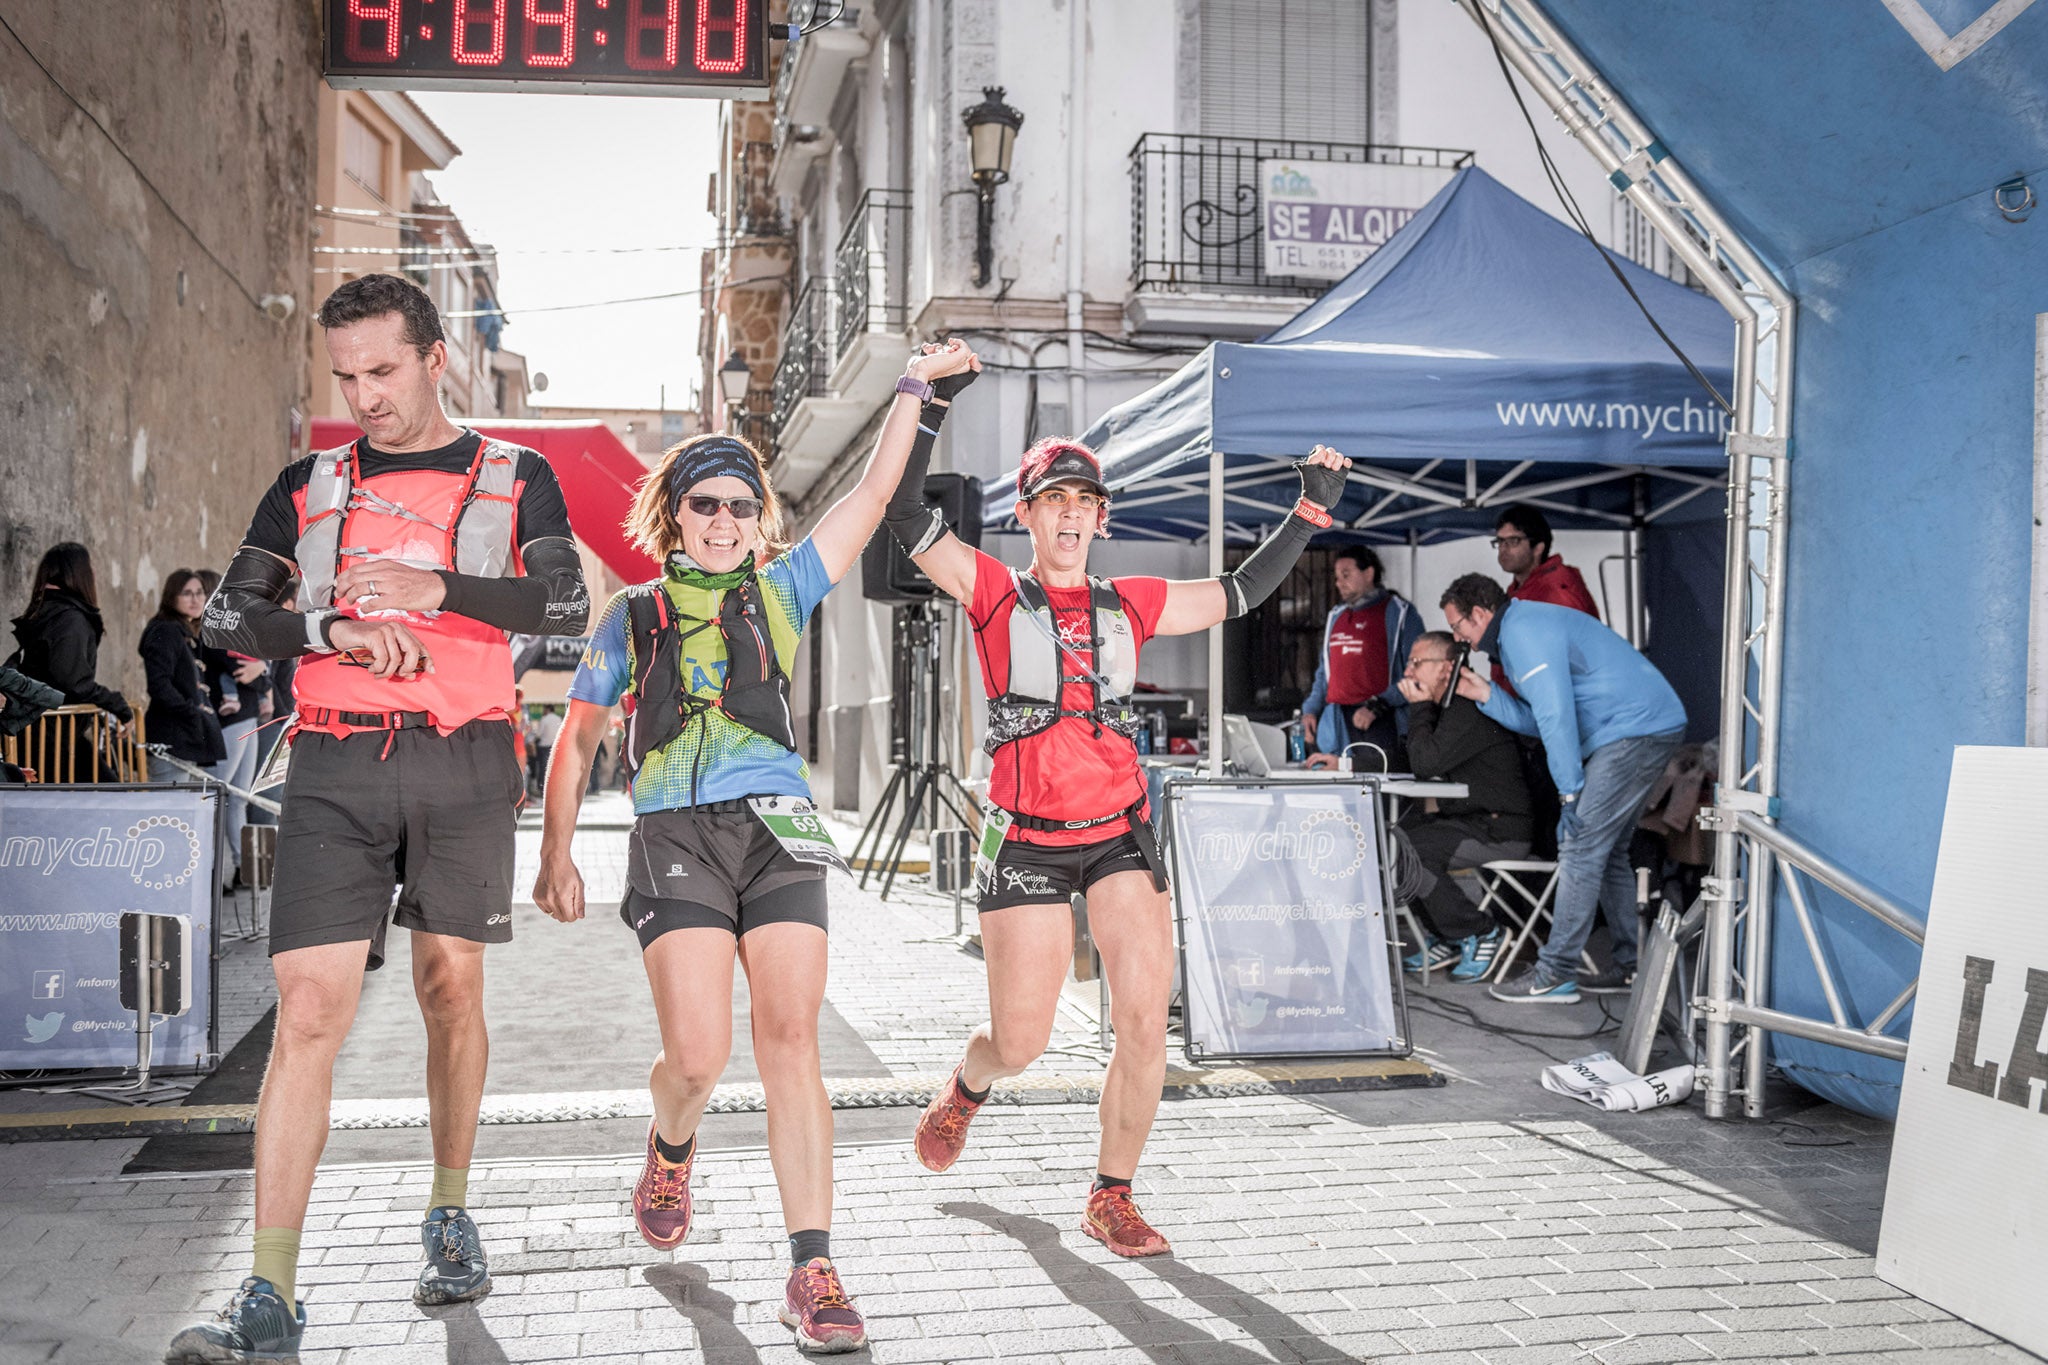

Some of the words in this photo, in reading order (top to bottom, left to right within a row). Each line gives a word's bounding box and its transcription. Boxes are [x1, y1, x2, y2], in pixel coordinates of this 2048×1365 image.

[1273, 204, 1311, 239] SE
[1324, 207, 1413, 245] ALQU
[1, 827, 165, 877] mychip
[1197, 821, 1335, 870] mychip
[1202, 901, 1368, 926] www.mychip.es
[75, 976, 119, 988] /infomy
